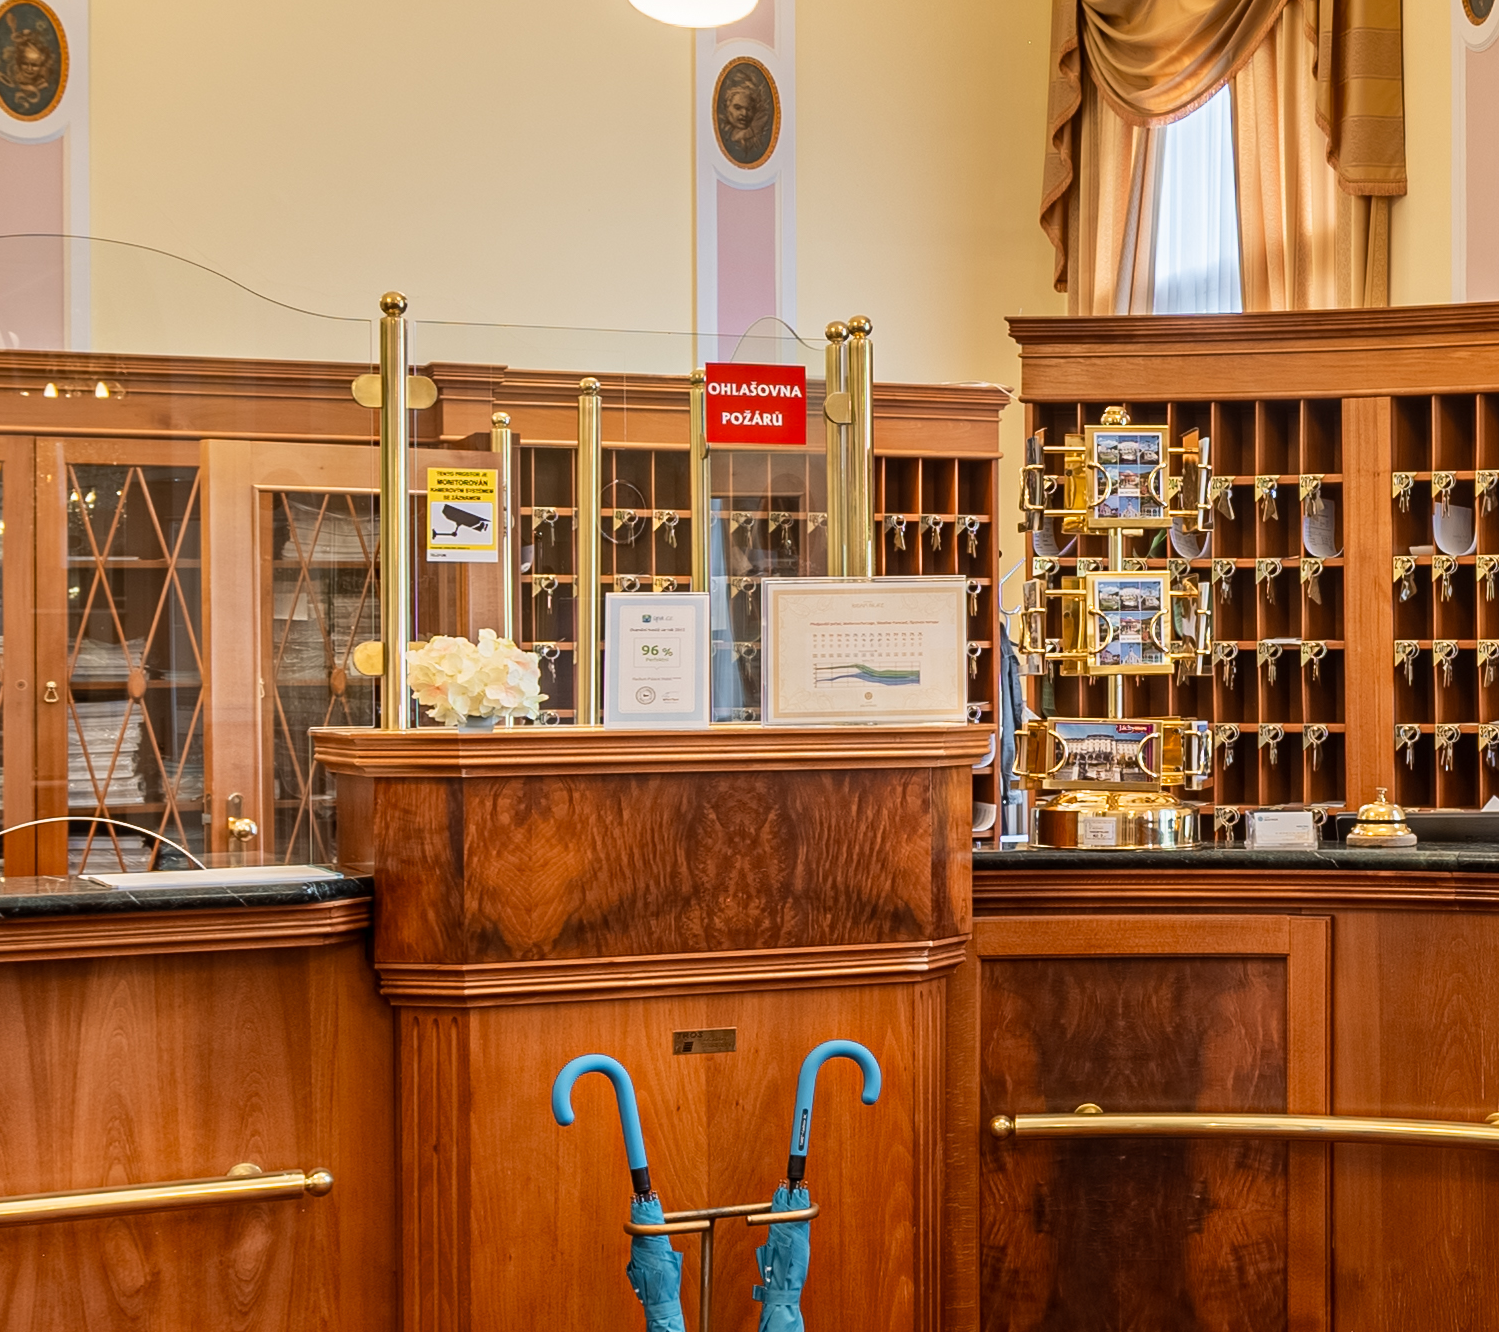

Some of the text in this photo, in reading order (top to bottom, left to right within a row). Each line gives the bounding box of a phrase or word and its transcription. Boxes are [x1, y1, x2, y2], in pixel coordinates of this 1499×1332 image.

[707, 380, 802, 398] OHLAŠOVNA
[721, 409, 783, 426] POŽÁRŮ
[641, 645, 659, 656] 96
